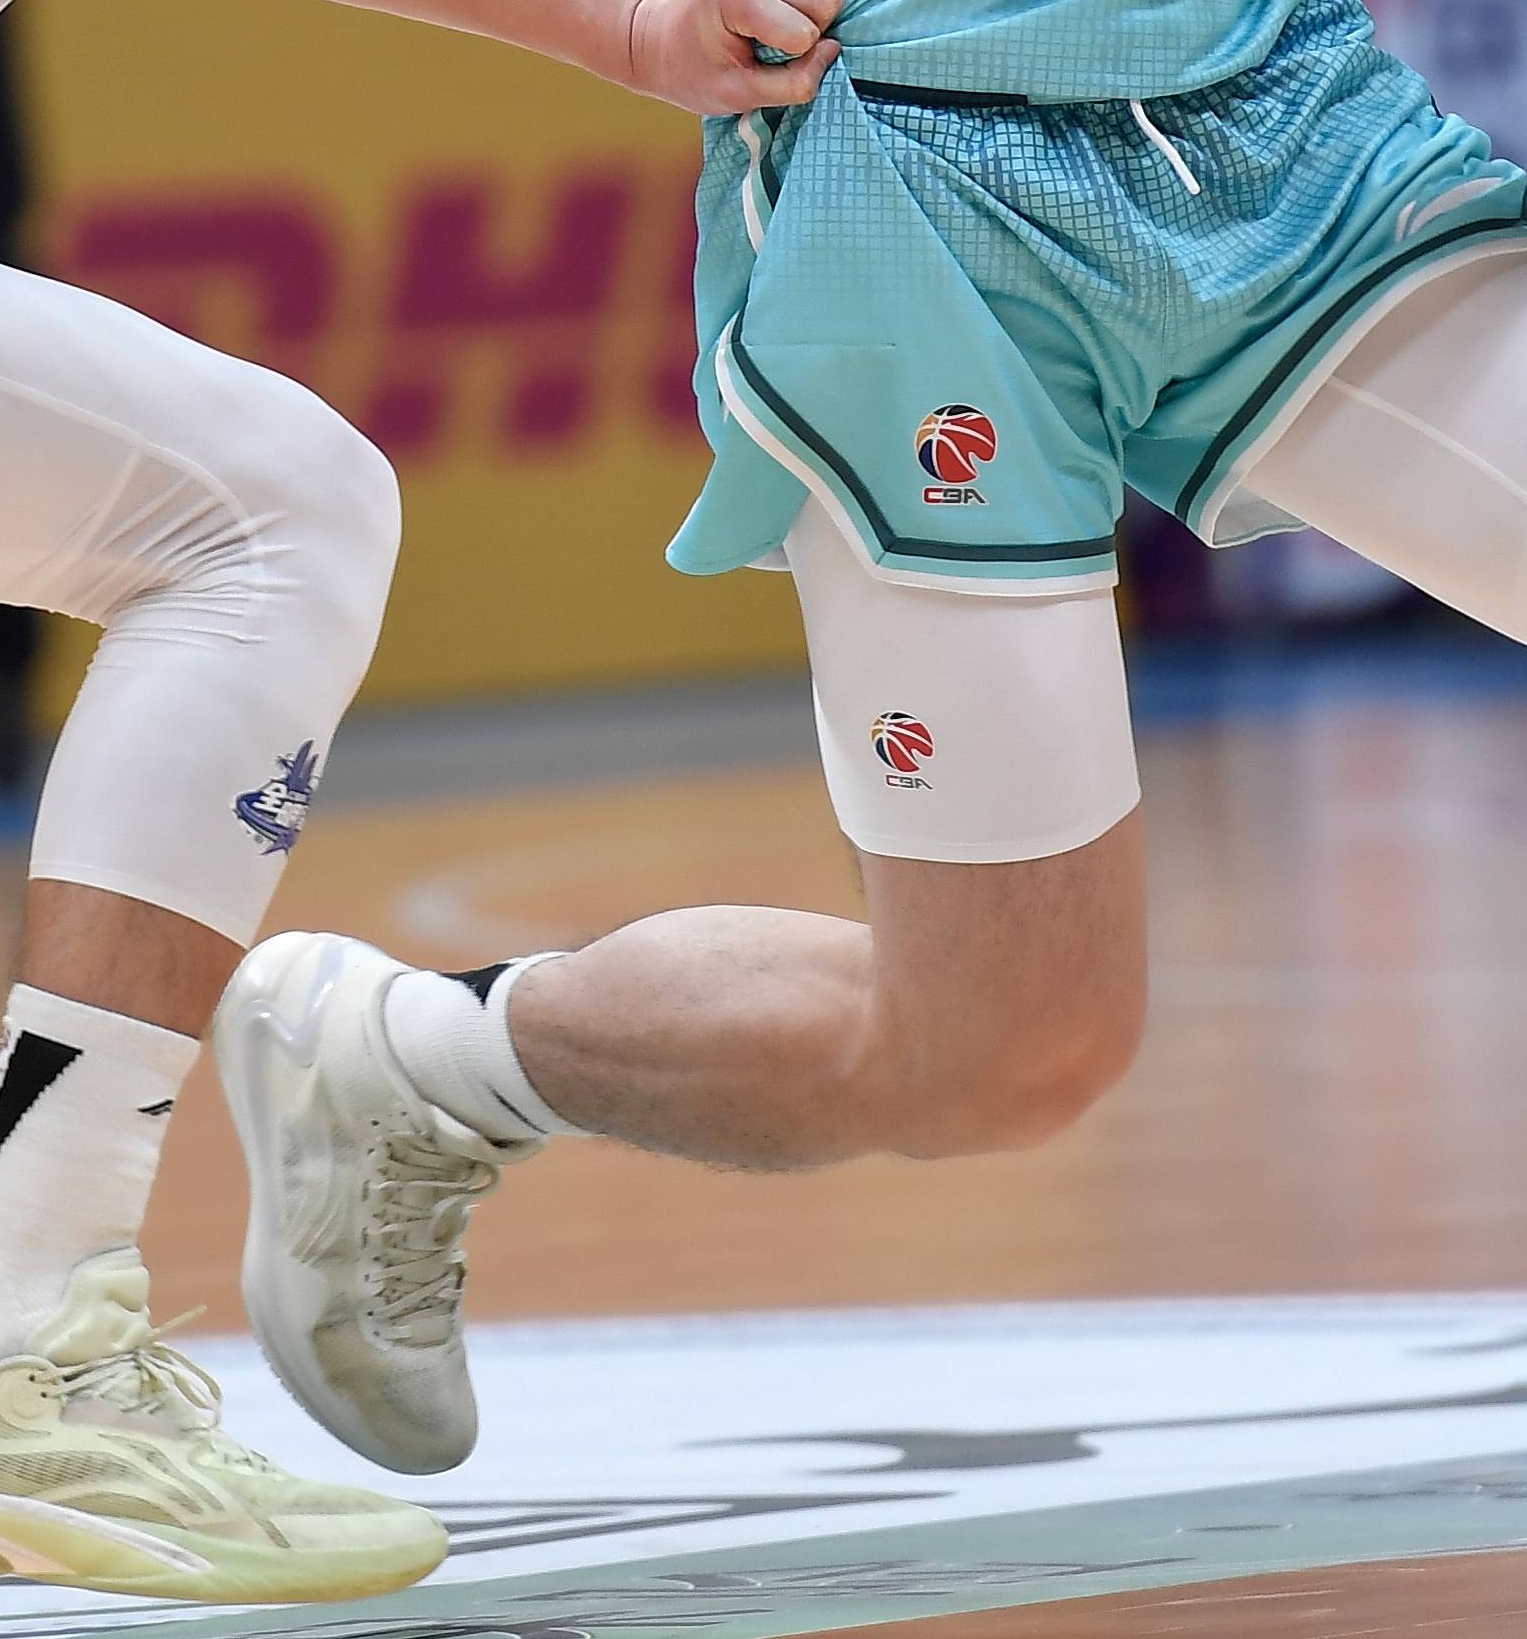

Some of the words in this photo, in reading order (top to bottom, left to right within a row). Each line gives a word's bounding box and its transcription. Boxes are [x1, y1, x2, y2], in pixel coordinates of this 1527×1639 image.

[62, 158, 700, 453] DH
[923, 487, 987, 505] CBA
[885, 774, 934, 791] CBA
